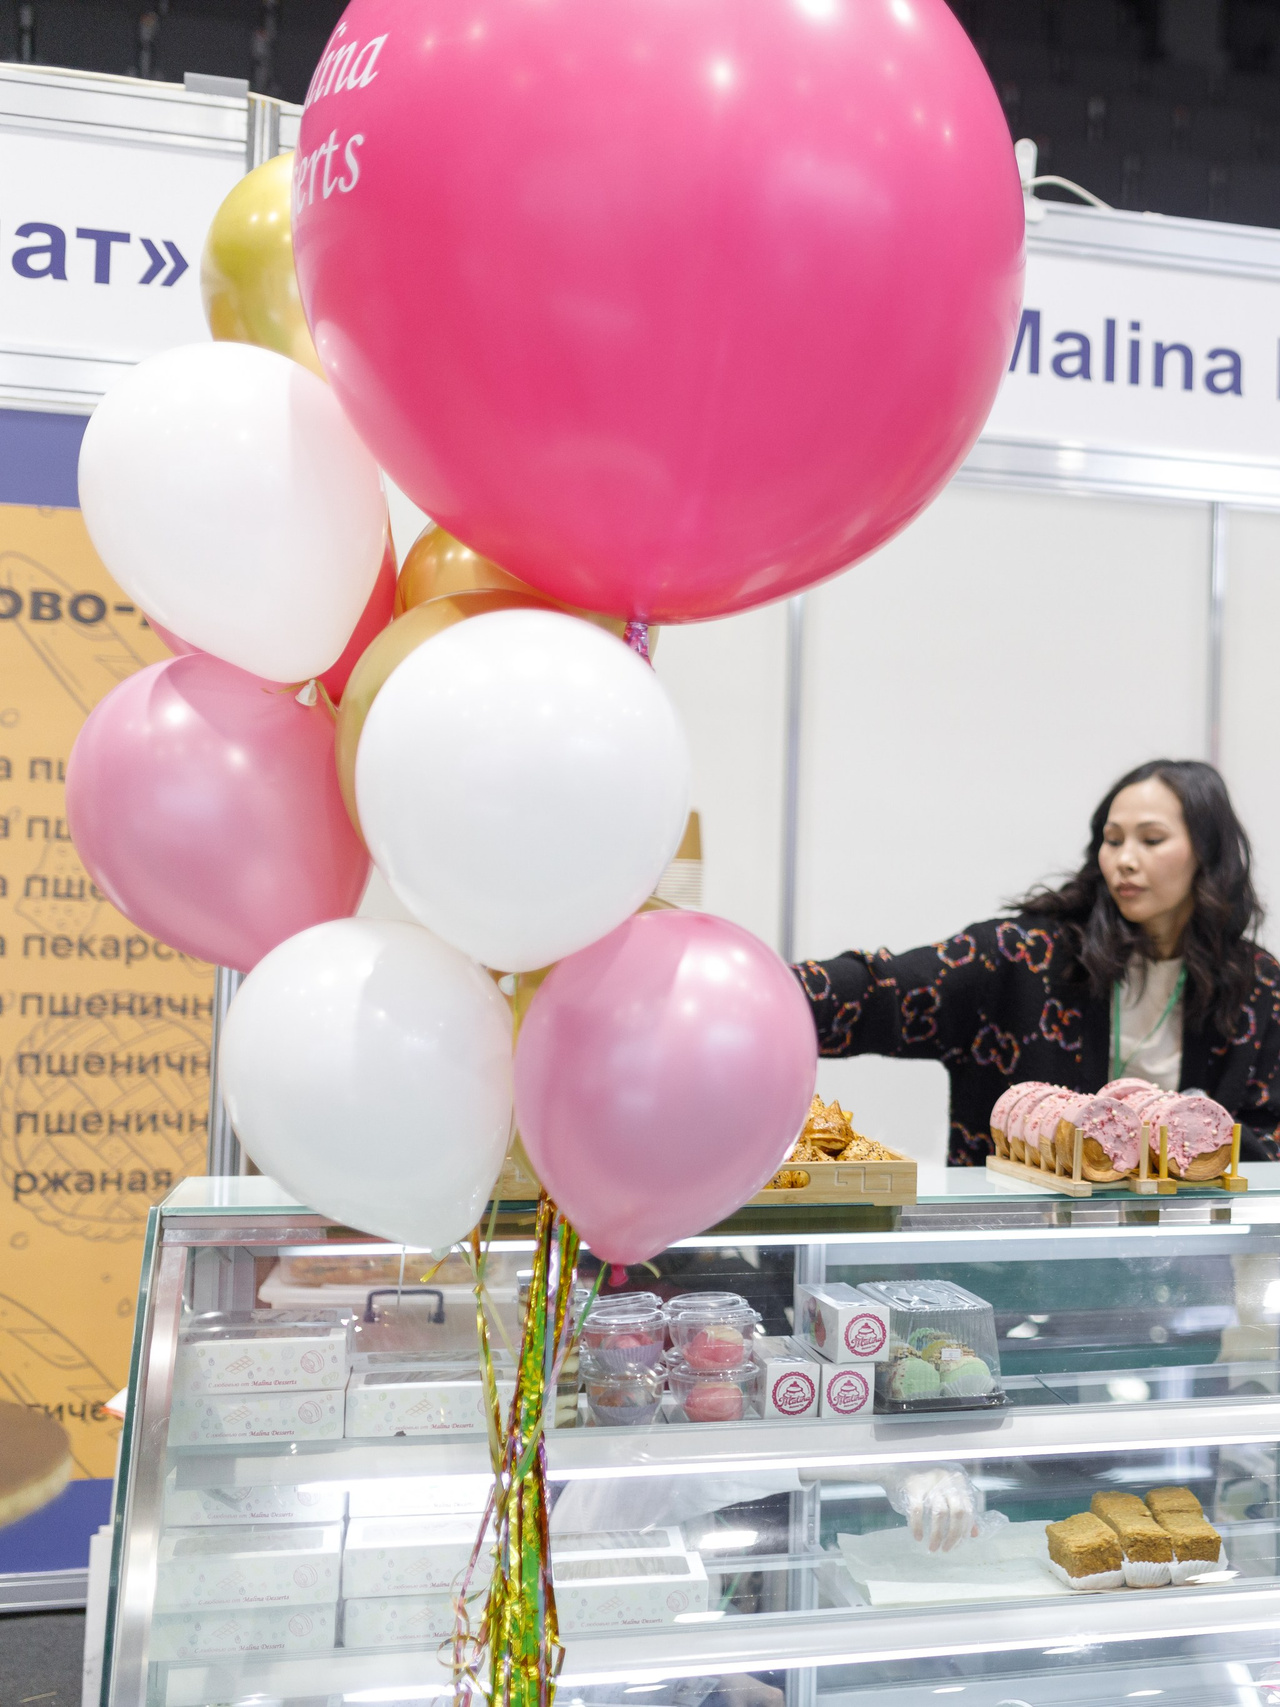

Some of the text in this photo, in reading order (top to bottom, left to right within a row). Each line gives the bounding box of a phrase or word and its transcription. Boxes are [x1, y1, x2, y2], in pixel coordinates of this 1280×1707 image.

[11, 221, 190, 287] ат»
[23, 932, 196, 967] пекарс
[13, 1168, 172, 1202] ржаная
